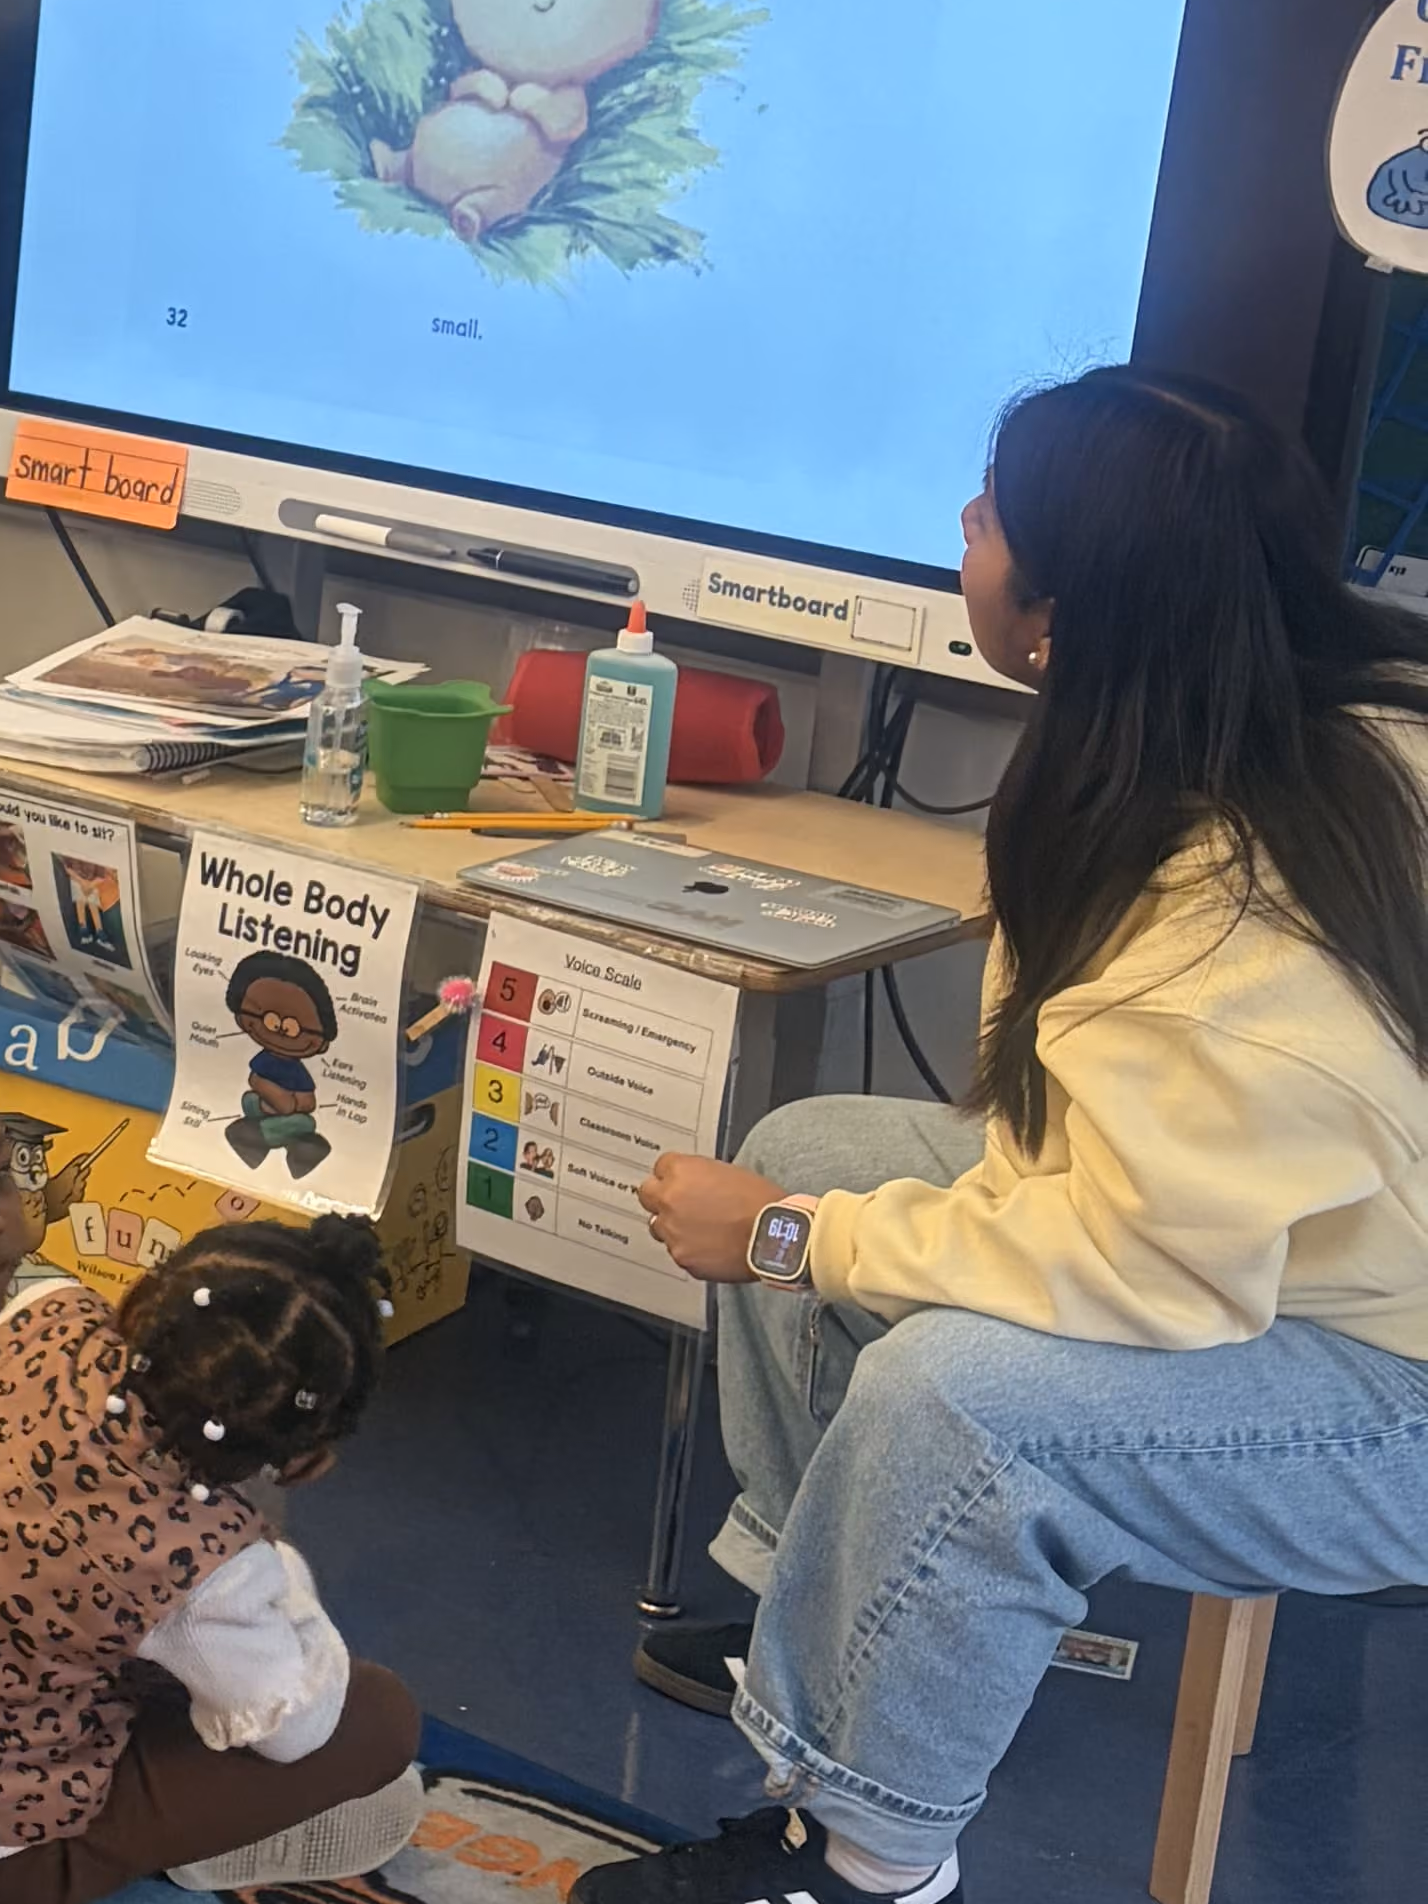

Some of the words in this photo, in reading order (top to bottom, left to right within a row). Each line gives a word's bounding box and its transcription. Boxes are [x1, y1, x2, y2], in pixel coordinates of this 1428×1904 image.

[166, 307, 188, 328] 32
[432, 316, 483, 340] small.
[14, 448, 91, 490] smart
[104, 454, 180, 505] board
[708, 572, 849, 621] Smartboard
[24, 809, 46, 824] you
[49, 814, 70, 830] like
[75, 820, 88, 834] to
[200, 851, 293, 906] Whole
[303, 880, 390, 940] Body
[218, 903, 361, 977] Listening
[564, 953, 601, 979] Voice
[604, 966, 642, 991] Scale
[500, 977, 517, 1002] 5
[582, 1008, 635, 1034] Screaming
[641, 1026, 696, 1054] Emergency
[4, 1024, 39, 1072] a
[492, 1032, 507, 1053] 4
[627, 1078, 654, 1096] Voice
[488, 1079, 504, 1103] 3
[484, 1128, 499, 1152] 2
[484, 1175, 493, 1200] 1
